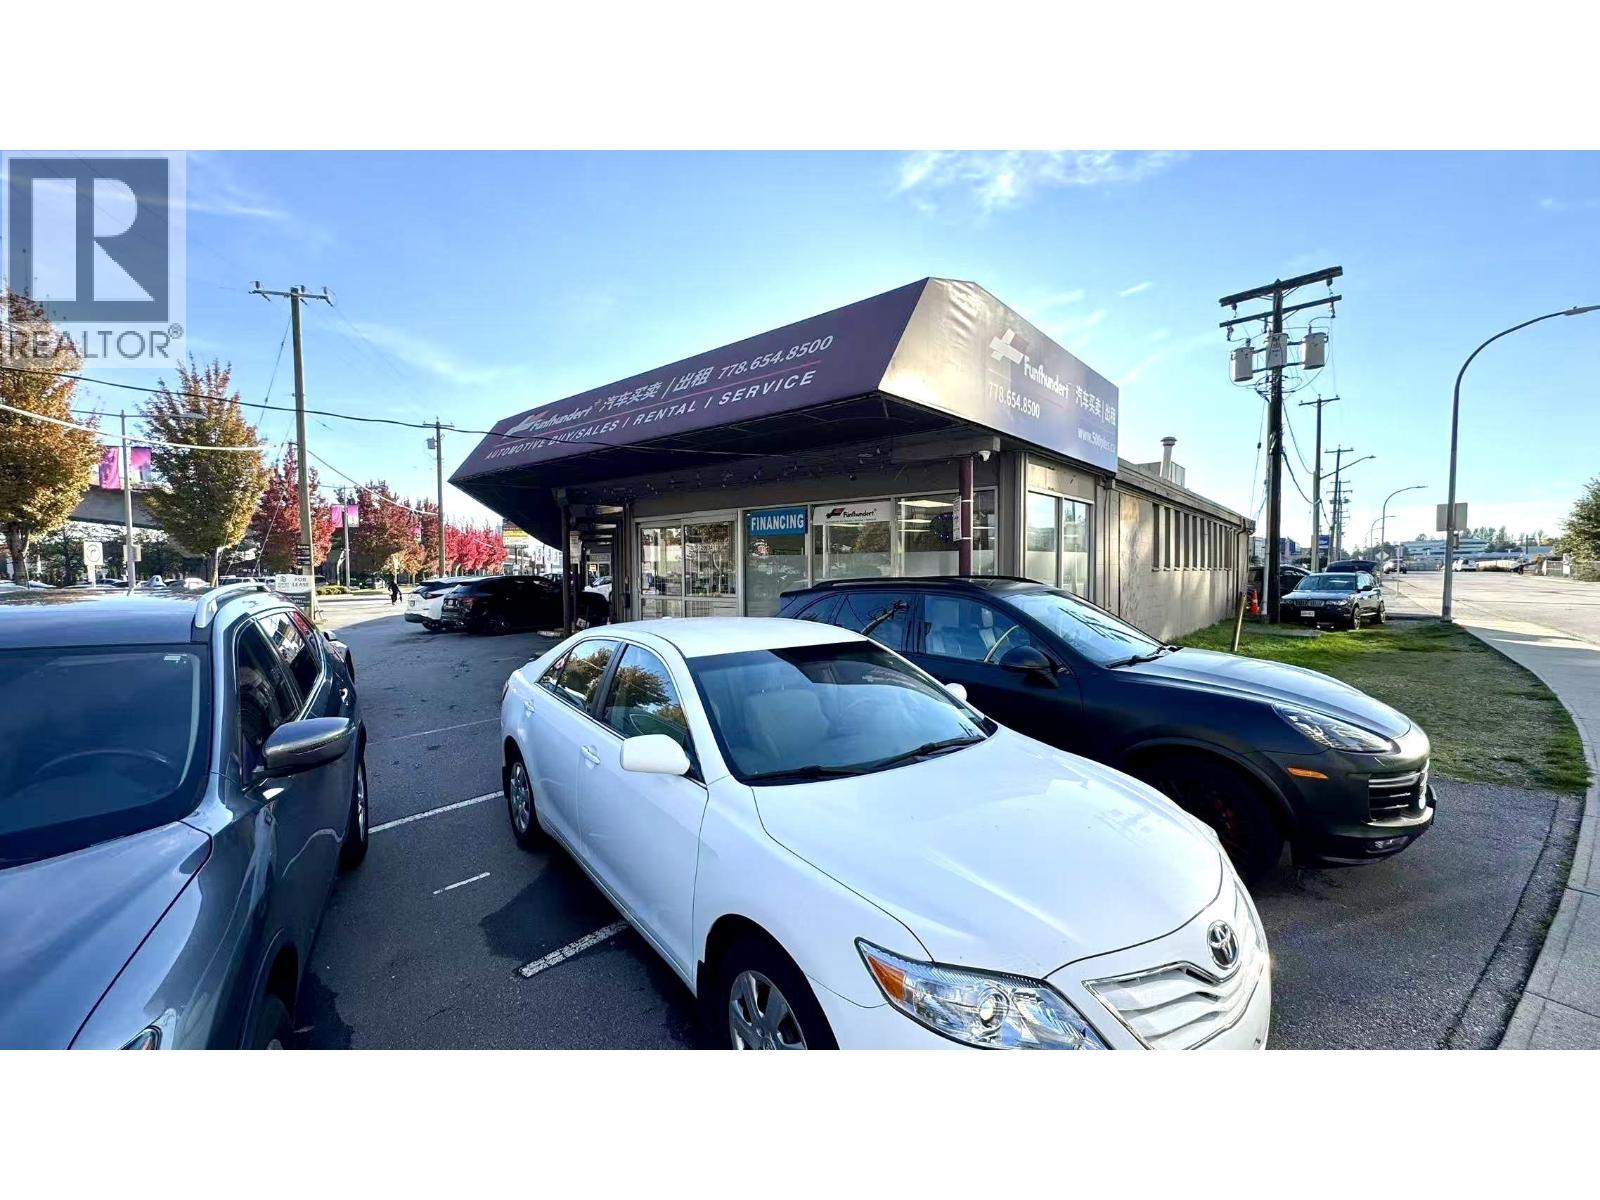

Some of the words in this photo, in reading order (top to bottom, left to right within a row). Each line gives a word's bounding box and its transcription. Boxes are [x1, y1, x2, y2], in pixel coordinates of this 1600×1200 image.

[718, 336, 834, 380] 778.654.8500
[485, 439, 547, 460] AUTOMOTIVE
[633, 401, 696, 426] RENTAL
[718, 370, 817, 405] SERVICE
[989, 383, 1040, 419] 778.654.8500
[751, 514, 804, 531] FINANCING
